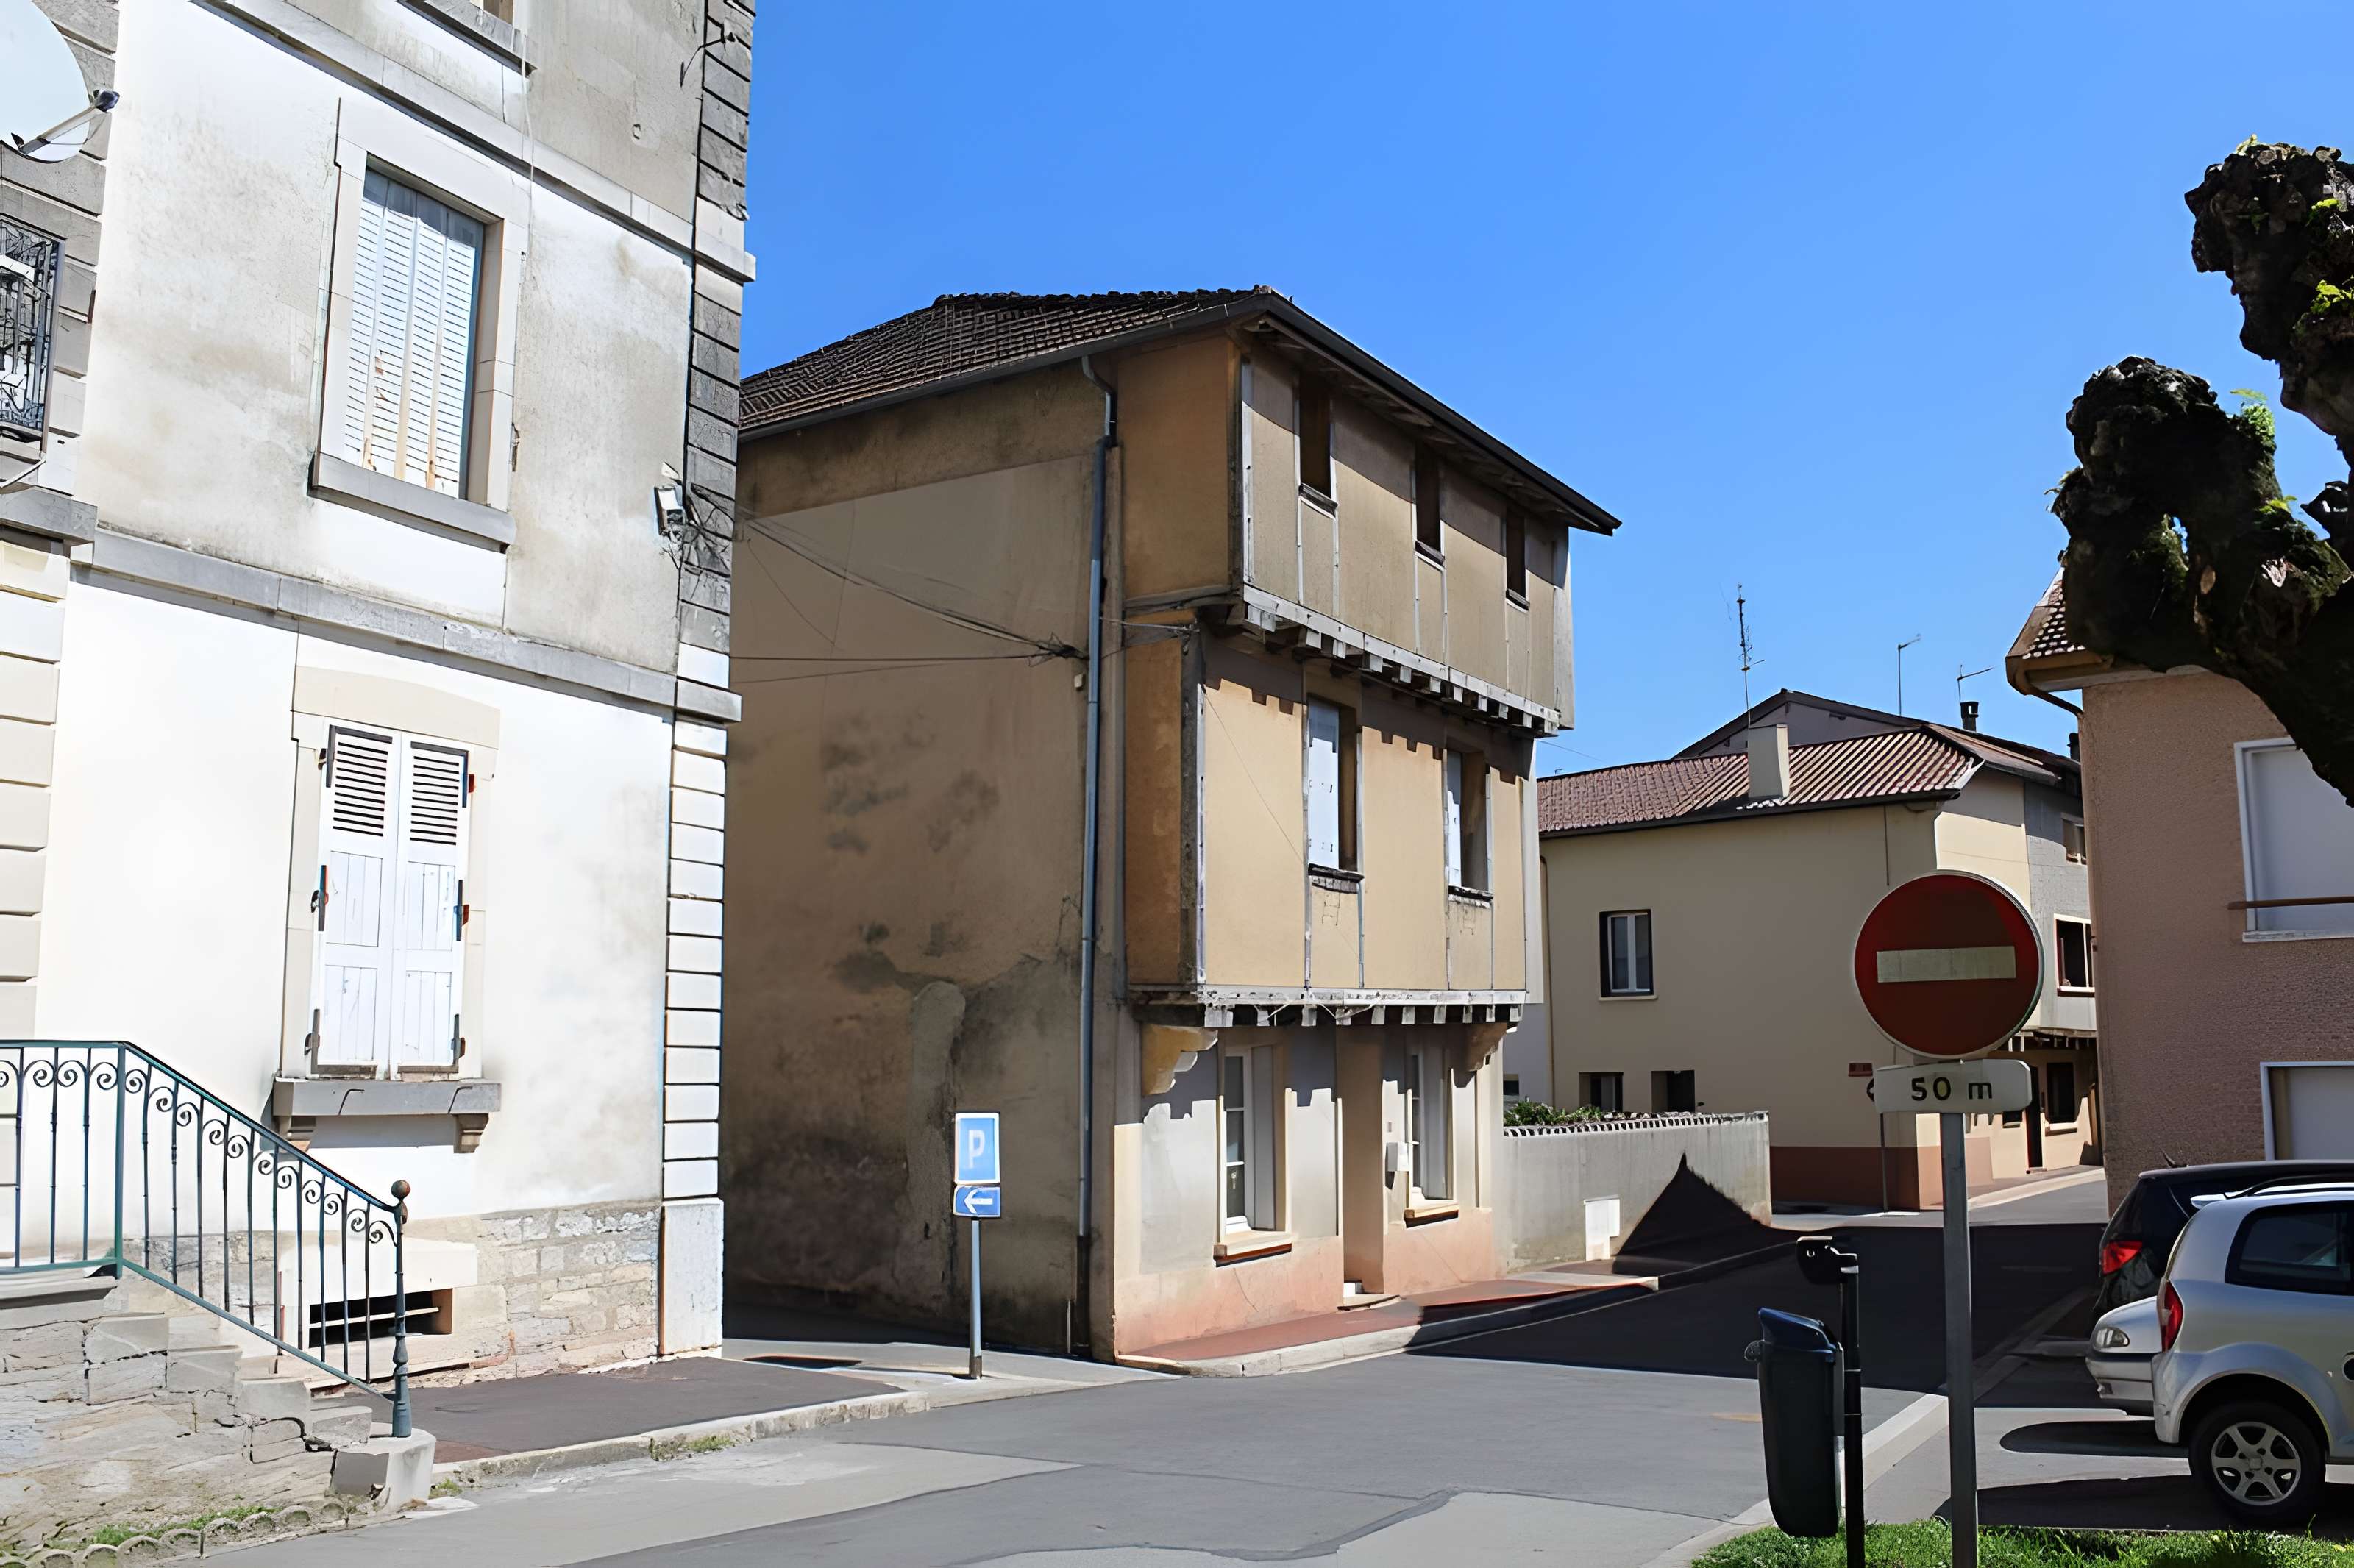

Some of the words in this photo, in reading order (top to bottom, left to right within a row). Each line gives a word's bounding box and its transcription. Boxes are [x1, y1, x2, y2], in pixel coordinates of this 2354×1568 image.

[1911, 1077, 1952, 1101] 50
[1968, 1082, 1993, 1100] m
[968, 1129, 986, 1169] P
